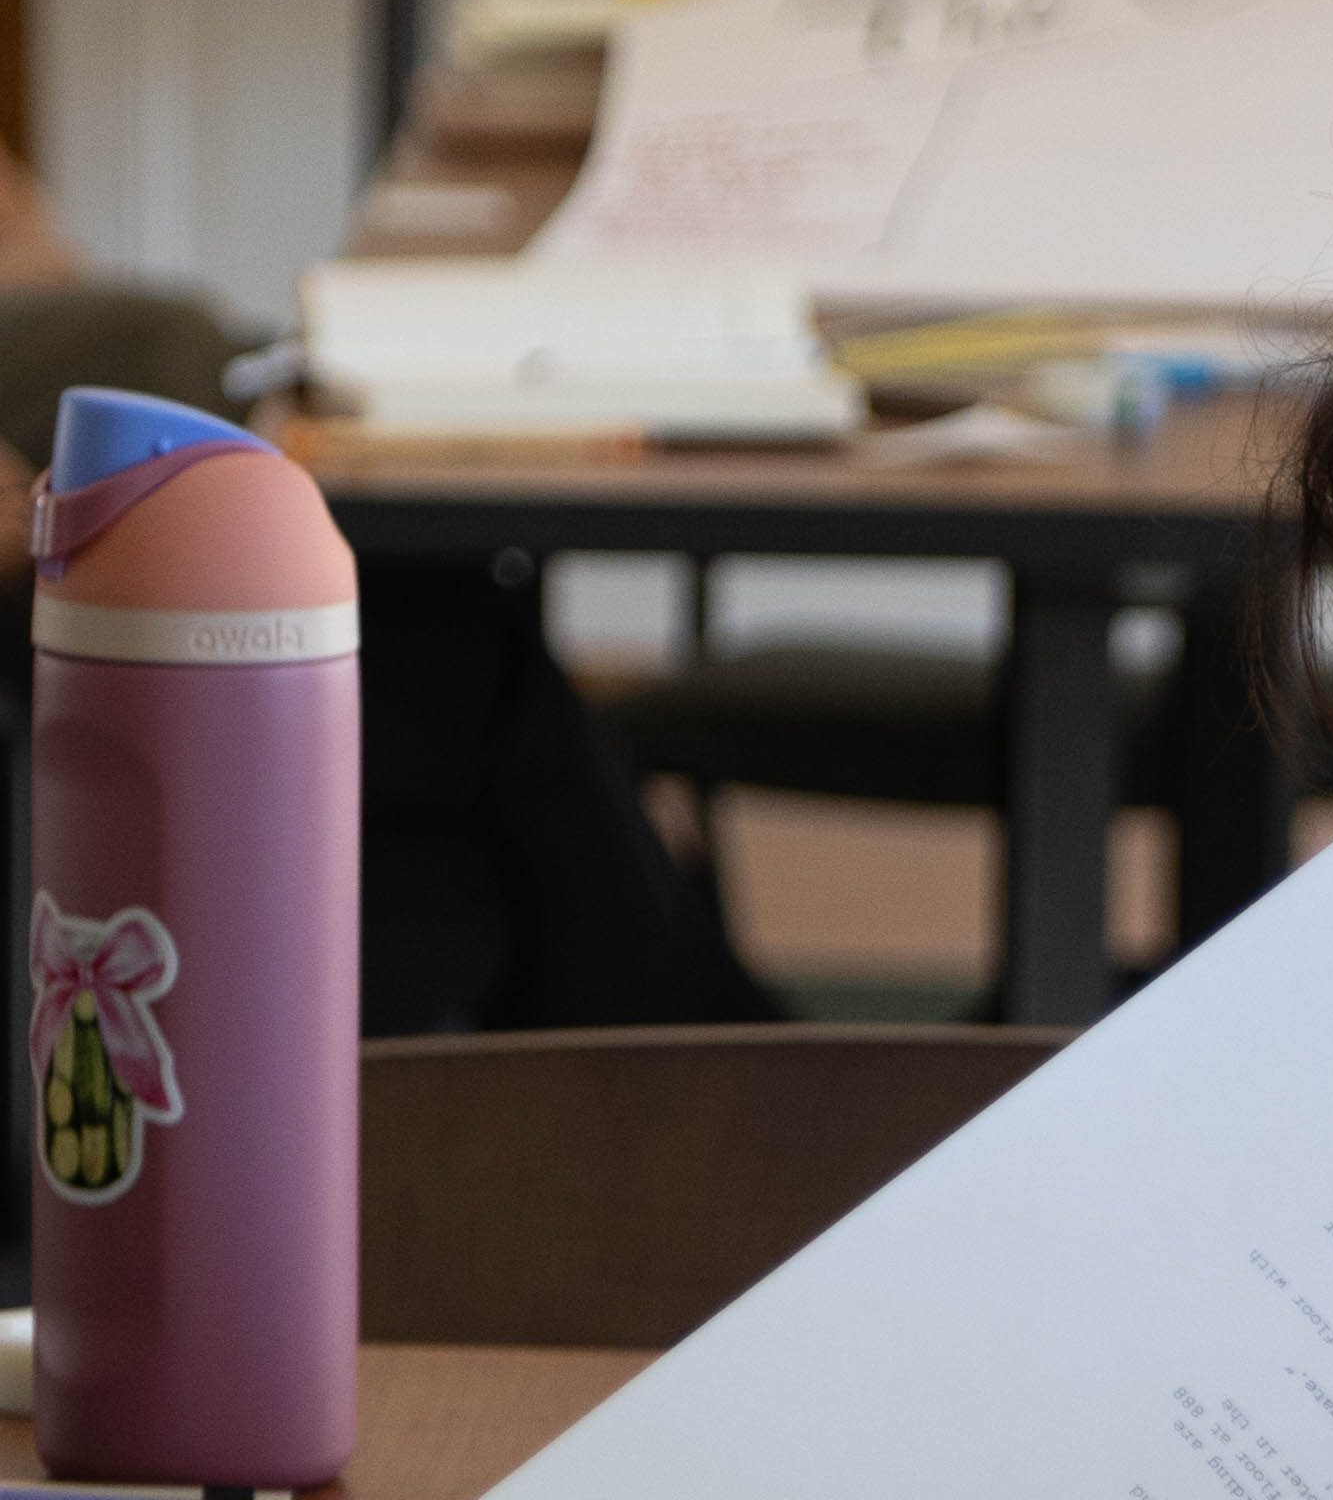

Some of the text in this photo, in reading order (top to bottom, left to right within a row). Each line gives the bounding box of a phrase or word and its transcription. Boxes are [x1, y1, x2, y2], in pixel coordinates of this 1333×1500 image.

[1249, 1248, 1288, 1289] with
[1221, 1398, 1249, 1430] the
[1173, 1419, 1203, 1449] are
[1256, 1435, 1277, 1458] in
